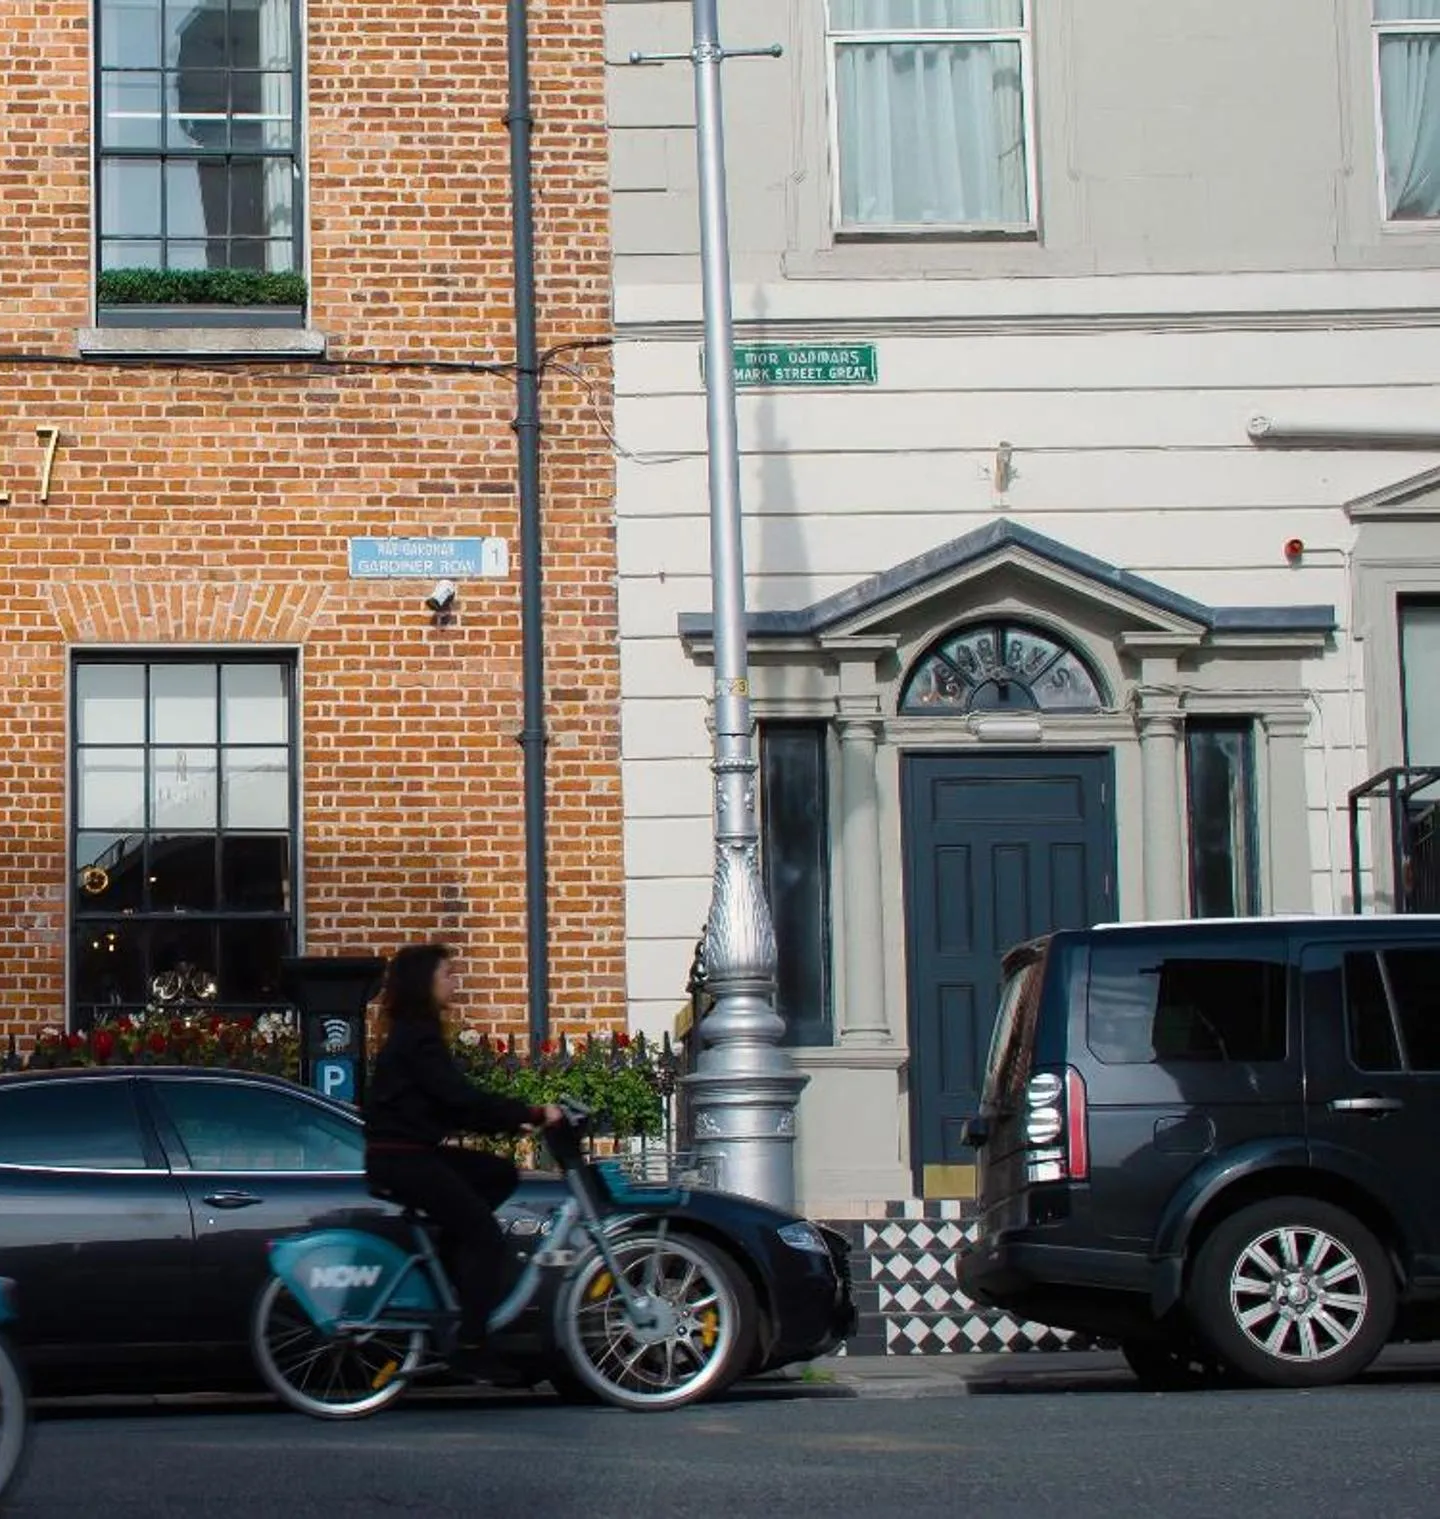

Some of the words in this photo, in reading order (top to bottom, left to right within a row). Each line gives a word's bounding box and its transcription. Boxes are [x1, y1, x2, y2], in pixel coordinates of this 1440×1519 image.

[734, 367, 770, 381] MARK
[775, 367, 823, 380] STREET
[828, 366, 868, 380] GREAT
[358, 559, 433, 573] GARDINER
[439, 559, 476, 573] ROW
[323, 1064, 346, 1096] P
[311, 1264, 384, 1289] NOW
